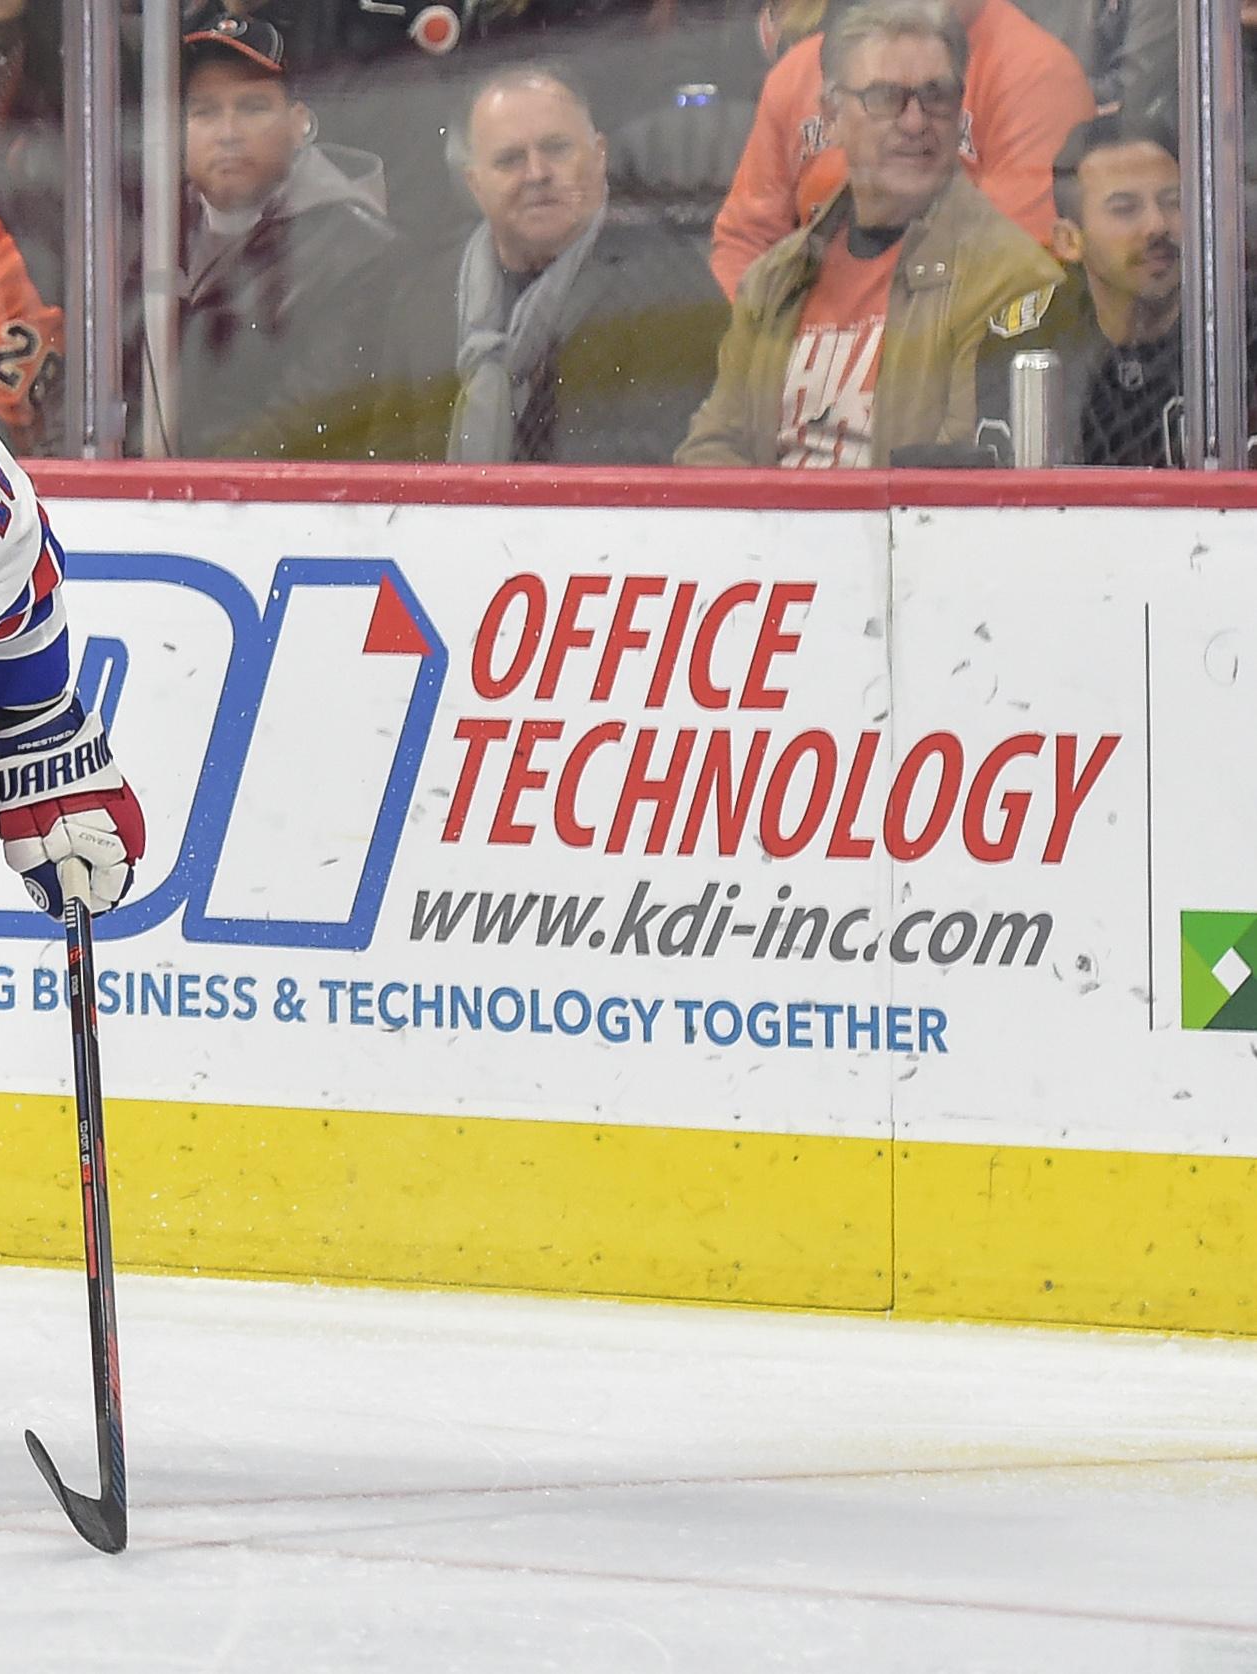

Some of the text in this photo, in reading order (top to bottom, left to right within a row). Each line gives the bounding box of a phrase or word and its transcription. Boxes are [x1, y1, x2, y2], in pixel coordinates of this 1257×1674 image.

[470, 571, 817, 711] OFFICE
[440, 718, 1123, 865] TECHNOLOGY
[408, 881, 1052, 966] www.kdi-inc.com
[32, 967, 257, 1022] BSINESS
[272, 977, 307, 1024] &
[319, 979, 664, 1044] TECHNOLOGY
[675, 999, 949, 1054] TOGETHER
